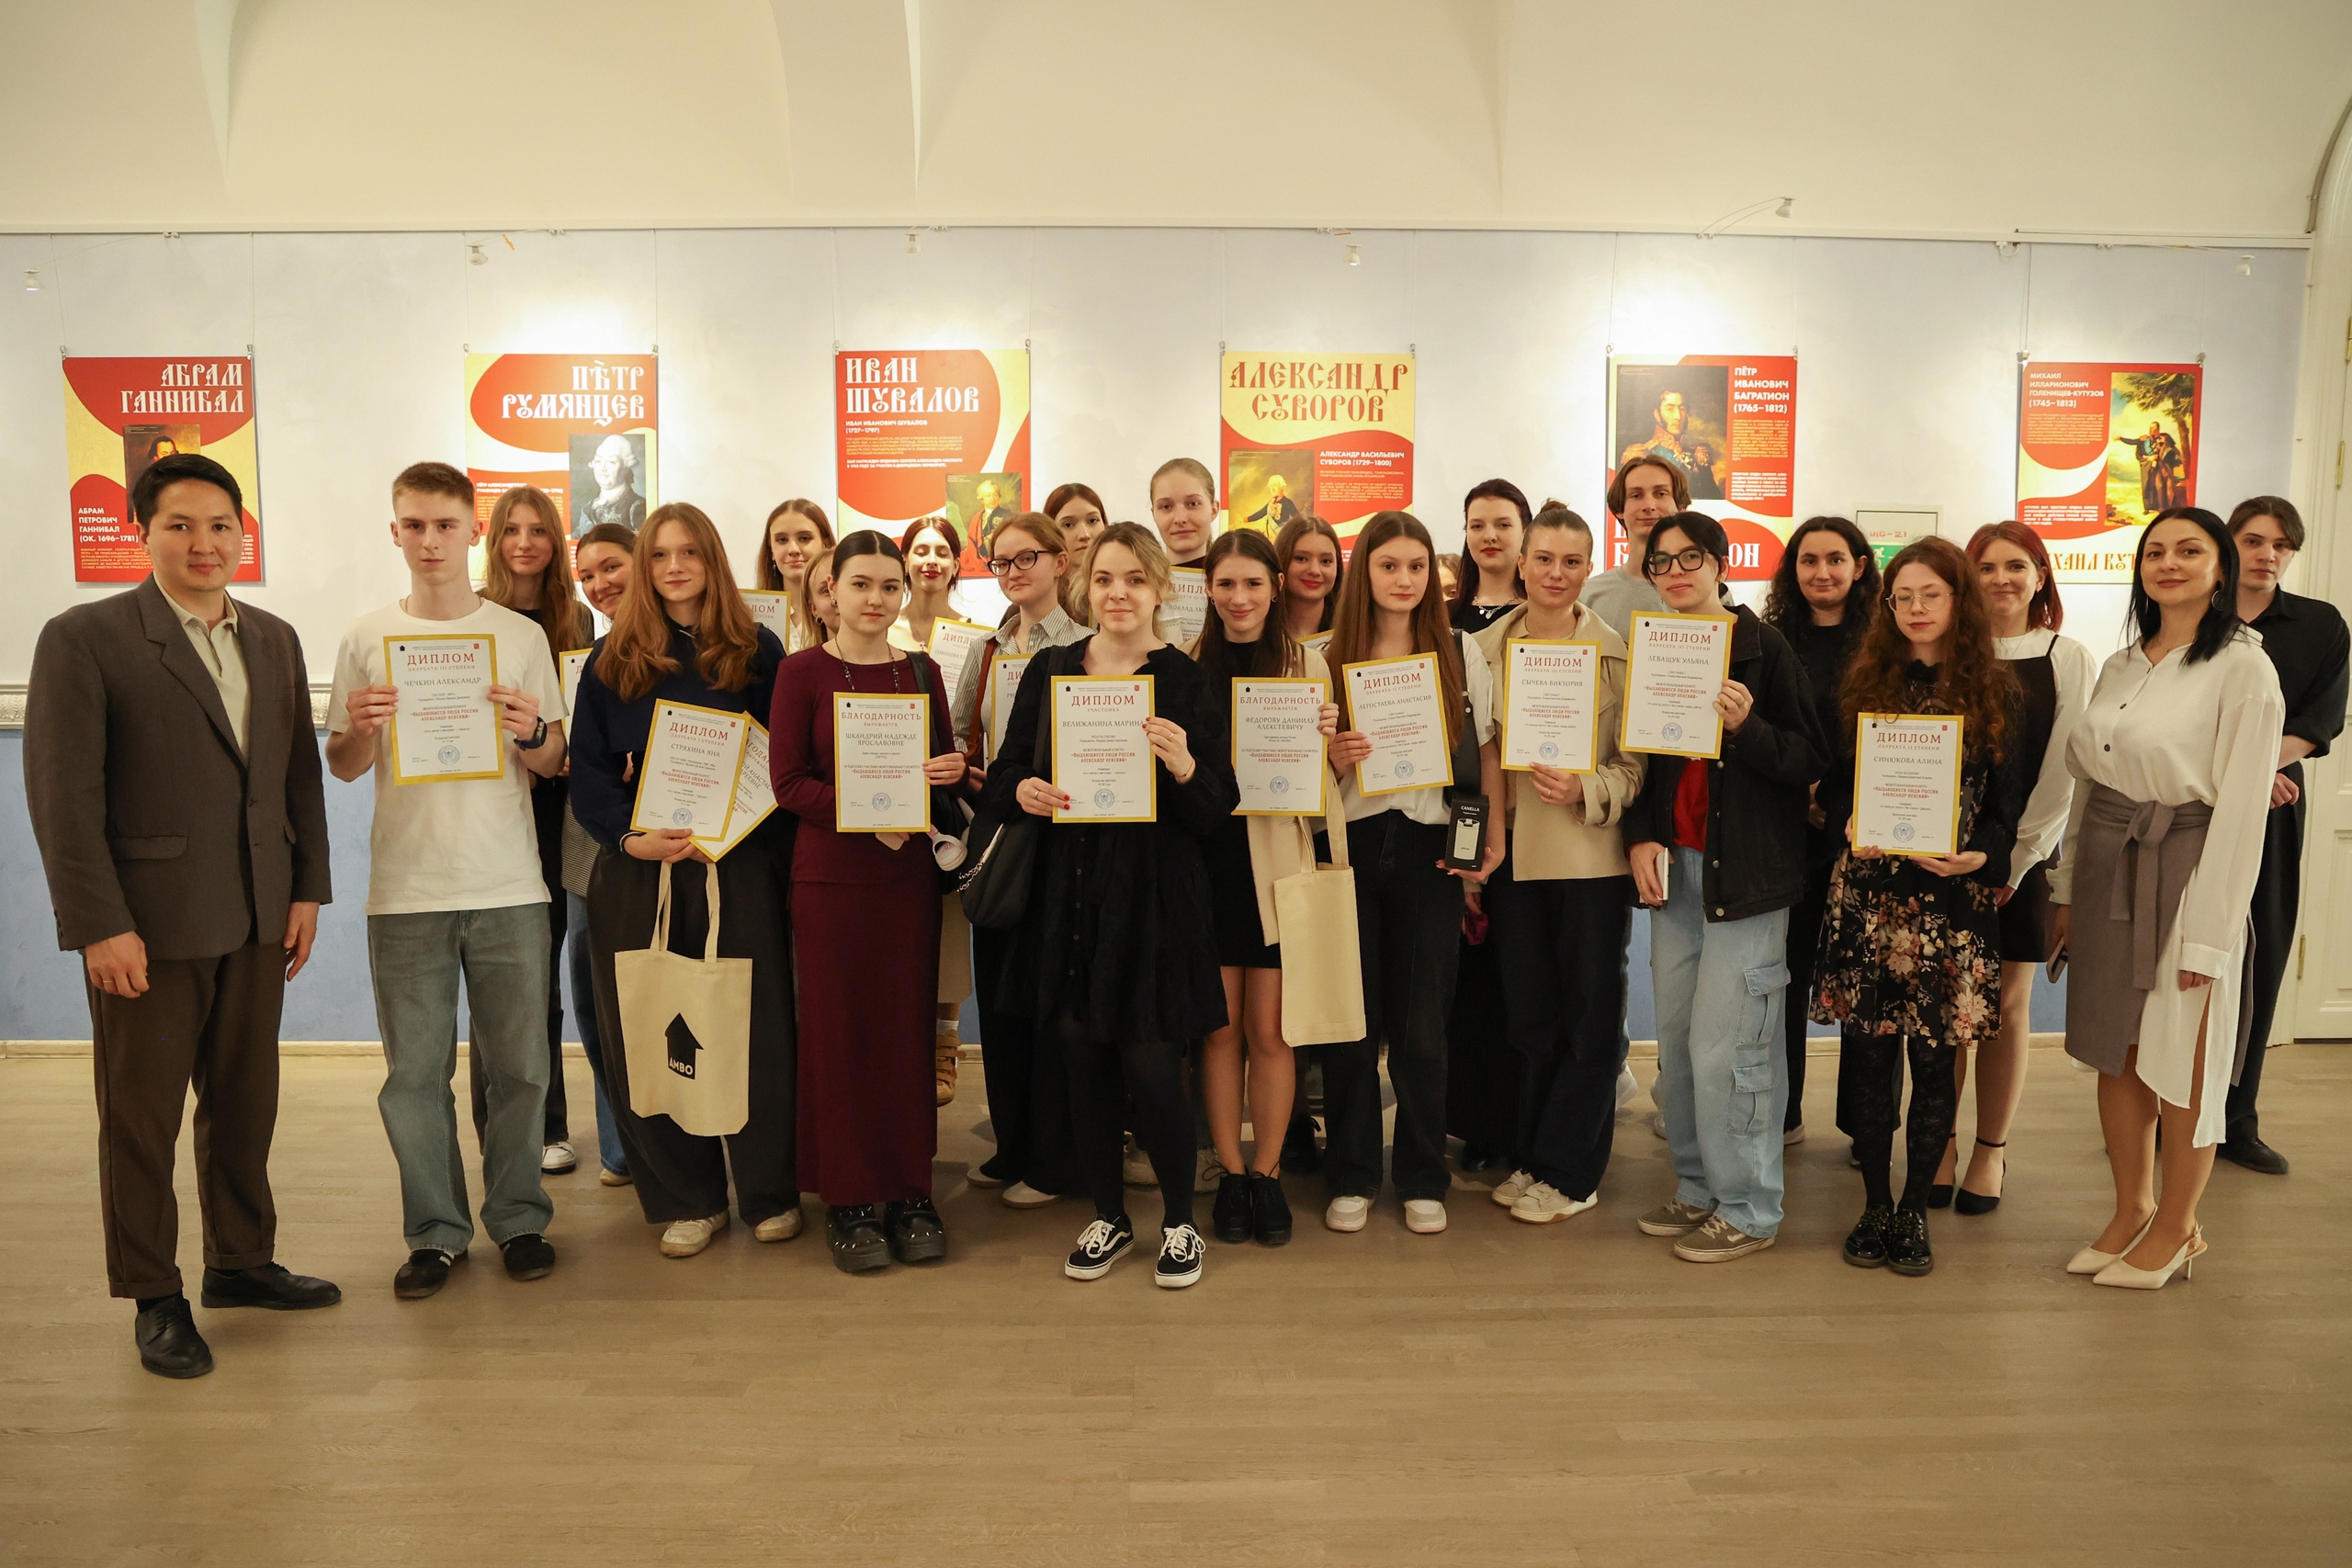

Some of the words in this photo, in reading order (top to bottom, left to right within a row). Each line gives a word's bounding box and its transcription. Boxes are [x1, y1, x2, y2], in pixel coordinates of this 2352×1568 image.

[161, 363, 243, 386] АБРАМ
[844, 357, 918, 383] ИВАН
[1735, 366, 1758, 376] ПЁТР
[1228, 362, 1408, 397] АЛЕКСАНДР
[1735, 379, 1789, 389] ИВАНОВИЧ
[845, 386, 979, 413] ШУВАЛОВ
[1734, 391, 1789, 401] БАГРАТИОН
[2030, 389, 2104, 398] ГОЛЕНИЩЕВ-КУТУЗОВ
[120, 389, 244, 413] ГАННИБАЛ
[502, 394, 644, 427] РУМЯНЦЕВ
[1251, 393, 1384, 423] СУВОРОВ
[1649, 631, 1711, 644] ДИПЛОМ
[407, 653, 475, 666] ДИПЛОМ
[1524, 657, 1582, 667] ДИПЛОМ
[436, 677, 481, 685] АЛЕКСАНДР
[1363, 673, 1421, 691] ДИПЛОМ
[1071, 695, 1134, 706] ДИПЛОМ
[1359, 700, 1396, 709] ЛЕГОСТАЕВА
[1397, 694, 1431, 705] АНАСТАСИЯ
[670, 722, 729, 740] ДИПЛОМ
[1877, 732, 1941, 743] ДИПЛОМ
[671, 743, 705, 754] СТРЯХИНА
[1873, 756, 1915, 764] СИНЮКОВА
